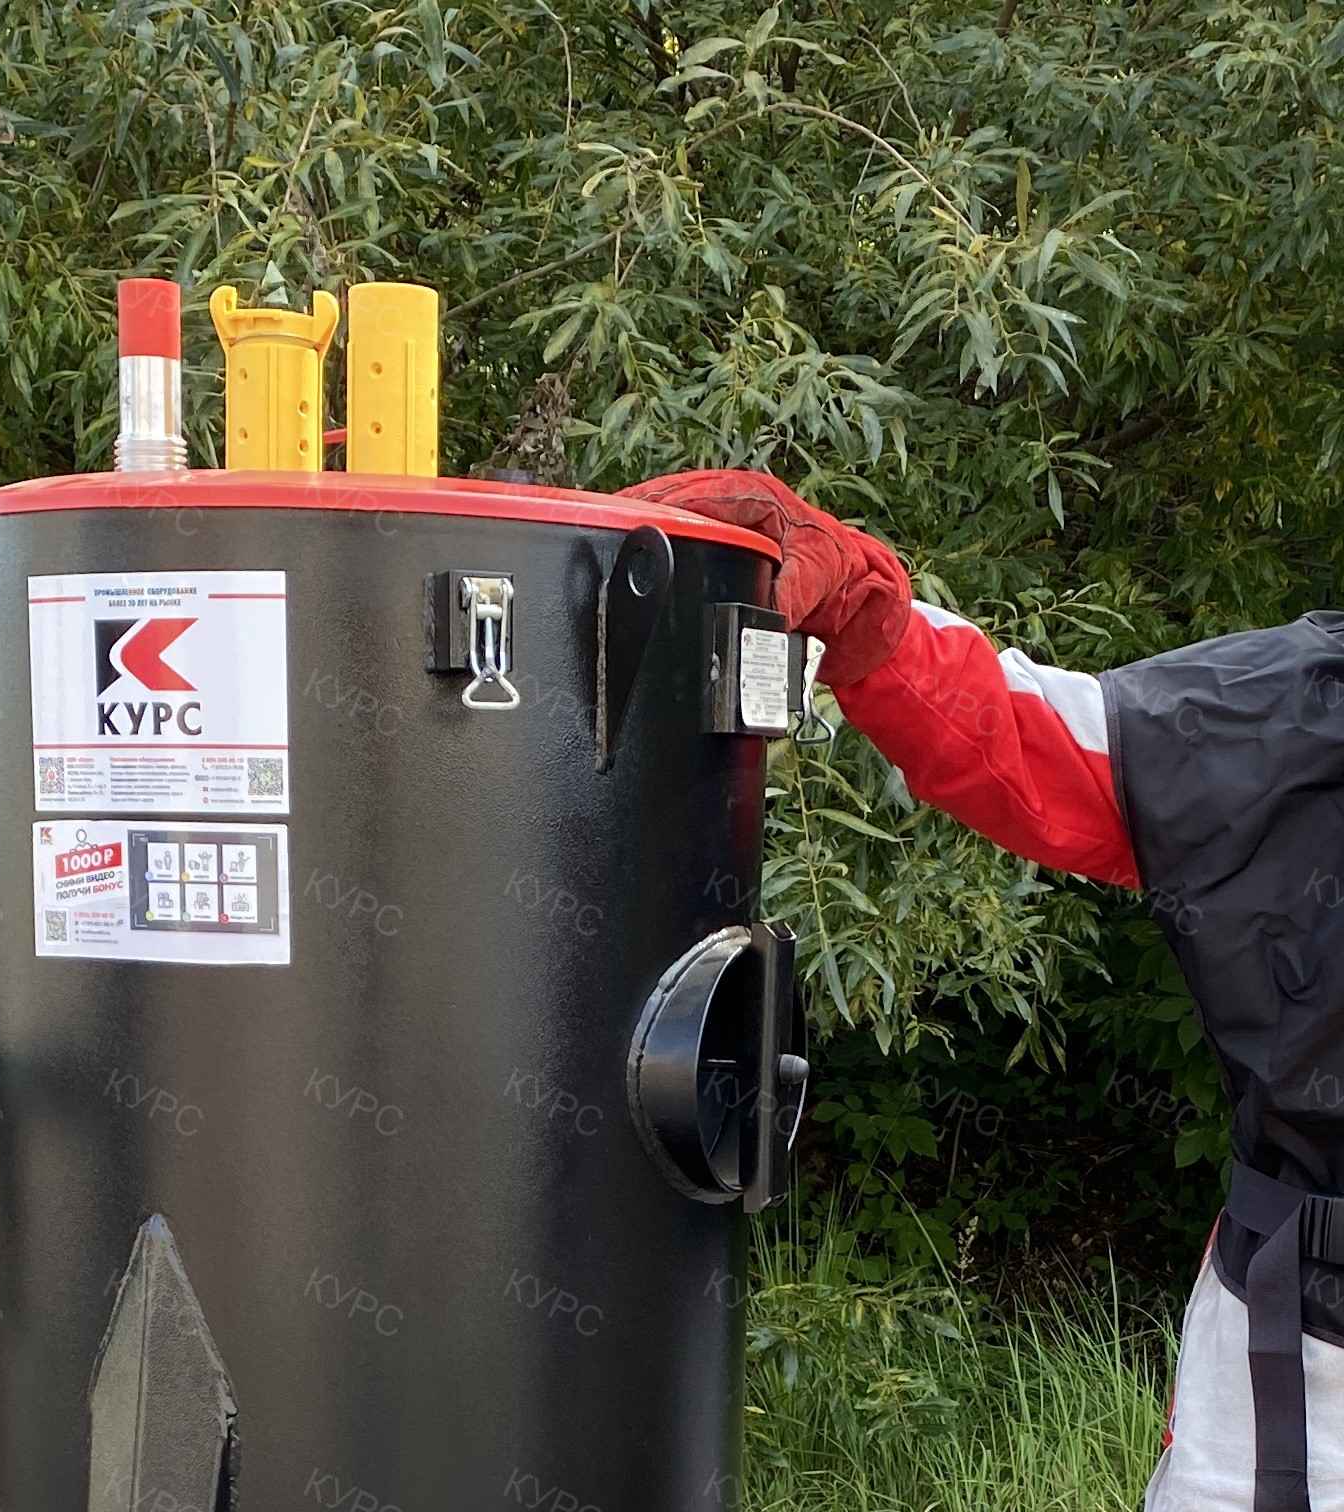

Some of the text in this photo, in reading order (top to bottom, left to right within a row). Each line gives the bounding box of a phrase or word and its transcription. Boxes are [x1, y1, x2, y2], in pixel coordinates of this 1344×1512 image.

[97, 702, 202, 736] КУРС
[86, 871, 115, 883] ВИДЕО
[56, 881, 124, 900] ПОЛУЧИ БОНУС
